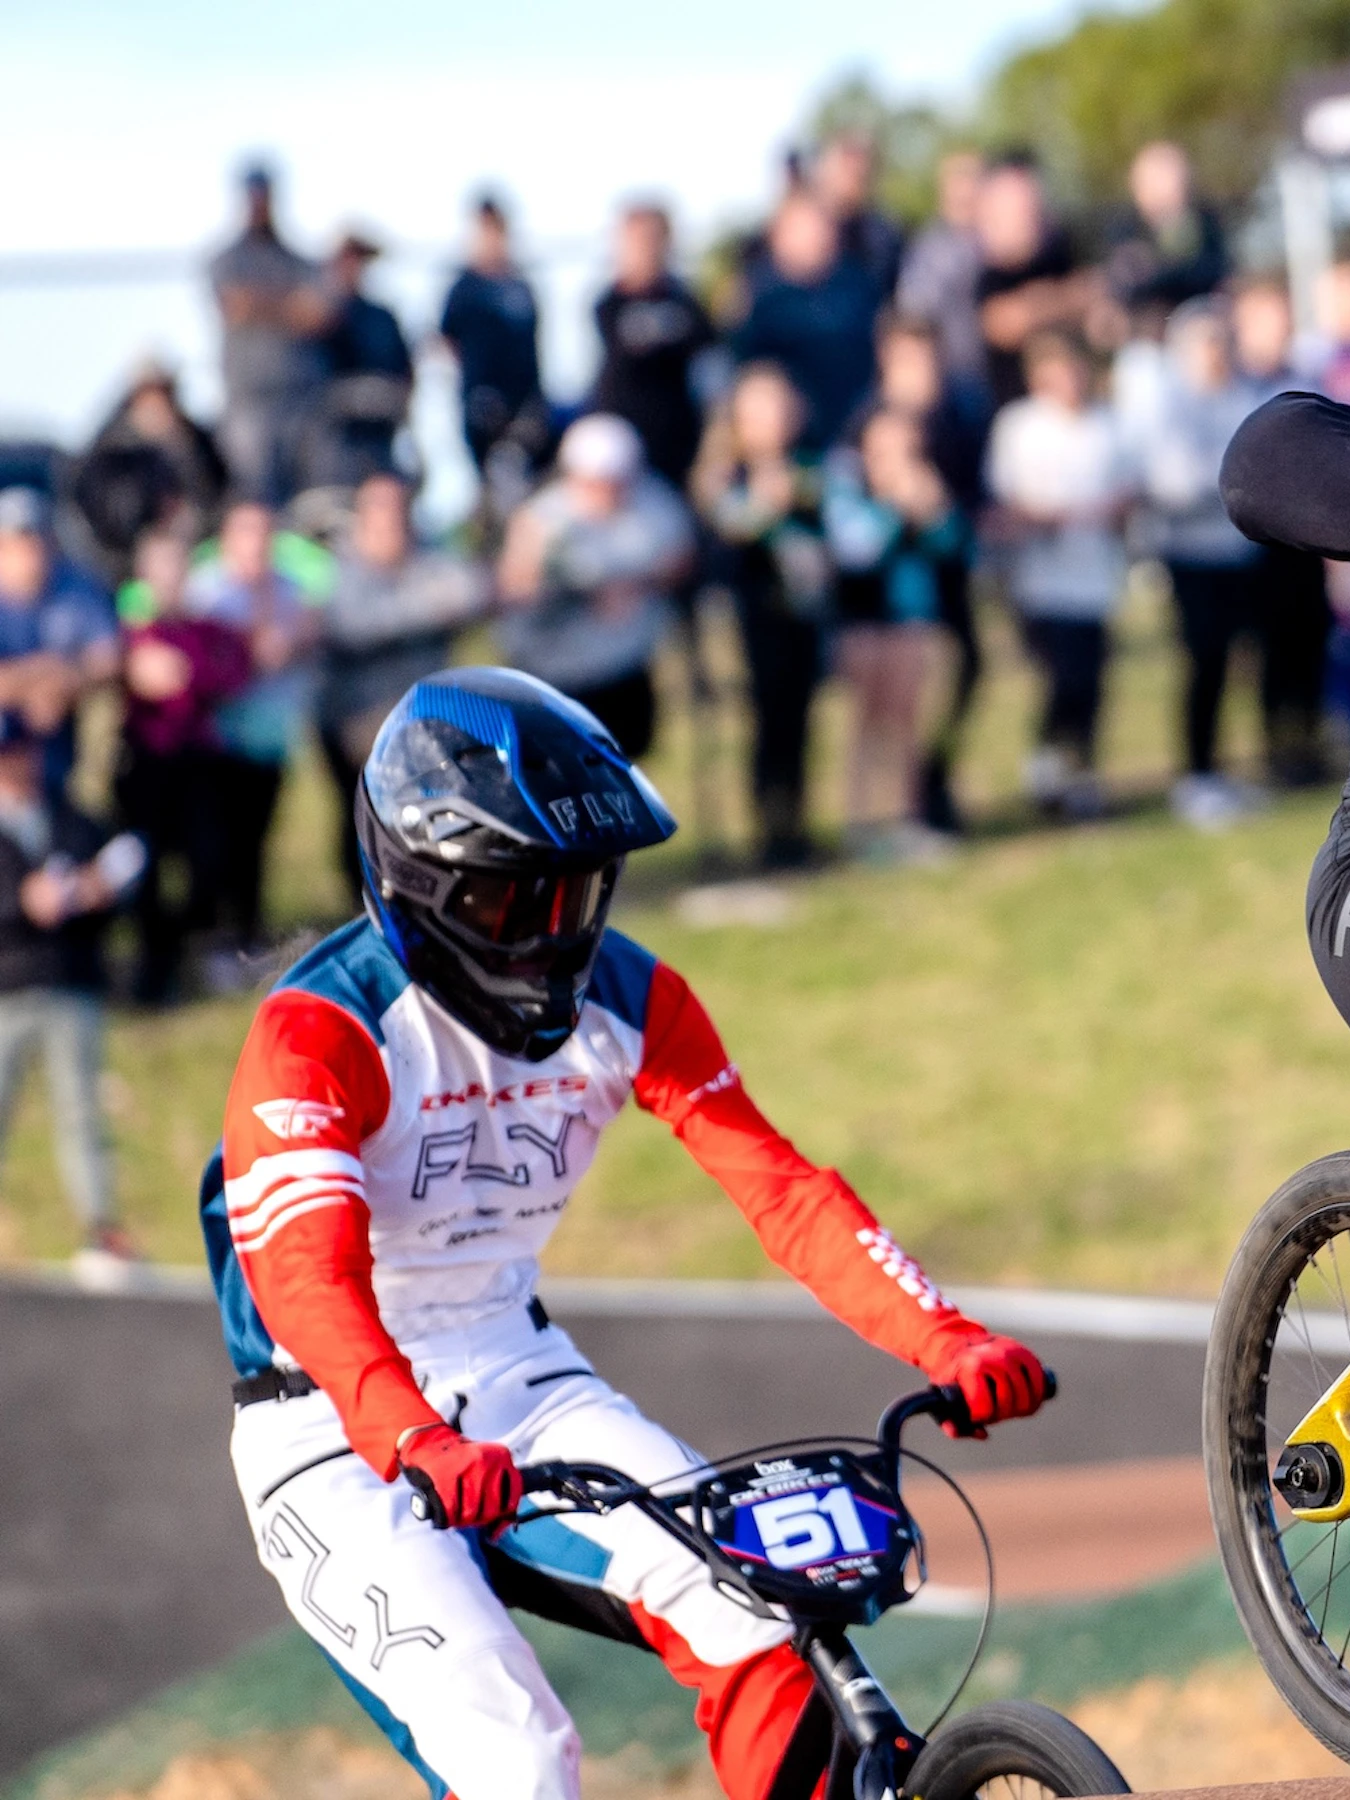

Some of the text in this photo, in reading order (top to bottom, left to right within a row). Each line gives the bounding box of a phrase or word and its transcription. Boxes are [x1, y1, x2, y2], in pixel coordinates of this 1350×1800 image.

[548, 791, 635, 833] FLY
[411, 1109, 590, 1200] FLY
[754, 1459, 796, 1476] box
[751, 1486, 870, 1571] 51
[263, 1500, 446, 1672] FLY
